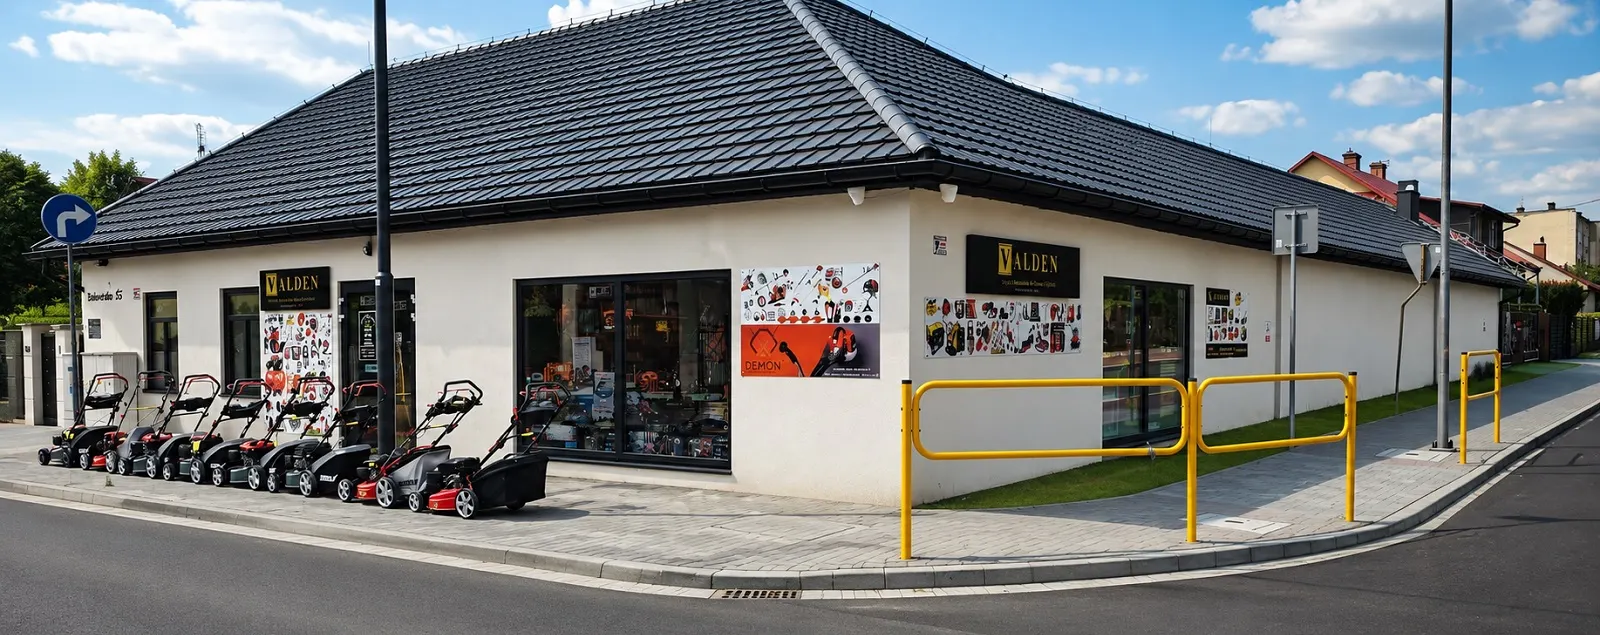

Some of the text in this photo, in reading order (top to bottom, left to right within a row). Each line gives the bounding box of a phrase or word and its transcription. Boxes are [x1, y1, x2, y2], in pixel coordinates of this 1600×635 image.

[1000, 246, 1058, 273] VALDEN
[266, 274, 319, 294] VALDEN
[745, 360, 781, 371] DEMON
